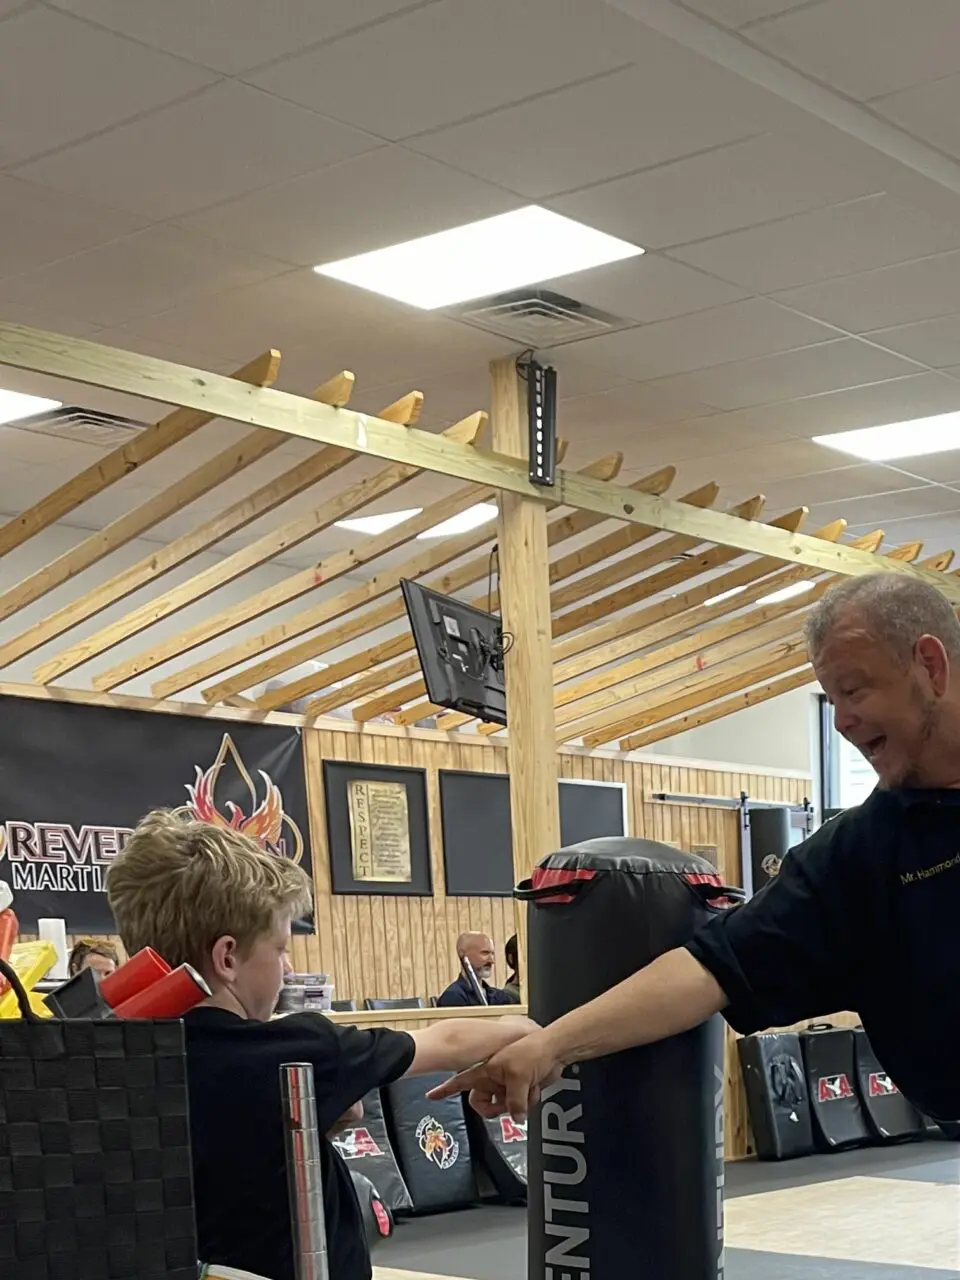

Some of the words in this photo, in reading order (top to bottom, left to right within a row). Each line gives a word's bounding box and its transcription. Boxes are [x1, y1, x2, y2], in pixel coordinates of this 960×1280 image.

[0, 820, 136, 865] REVE
[355, 784, 370, 877] RESPECT
[11, 862, 109, 892] MARTI
[900, 871, 917, 885] Mr.
